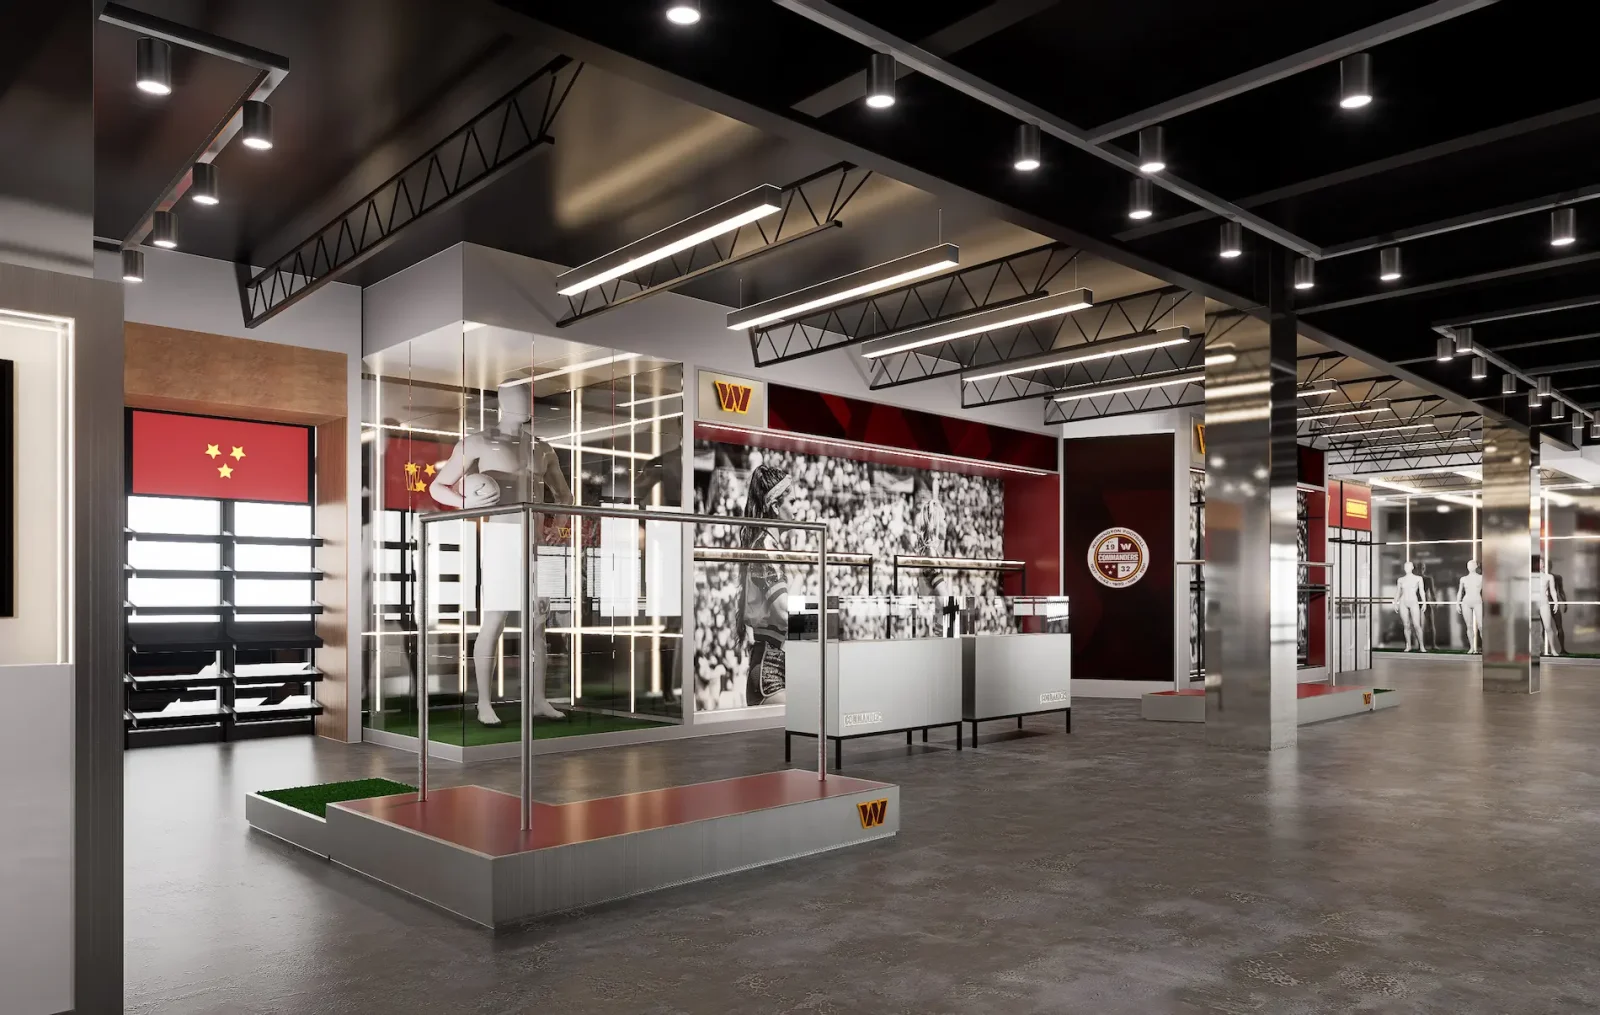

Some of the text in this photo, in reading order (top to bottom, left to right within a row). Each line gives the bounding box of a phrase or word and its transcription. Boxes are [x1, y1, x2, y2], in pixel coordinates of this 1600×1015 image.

[713, 380, 752, 415] W
[1092, 529, 1145, 549] WASHINGTON FOOTBALL
[1120, 543, 1132, 551] W
[1098, 553, 1139, 562] COMMANDERS
[856, 798, 888, 829] W
